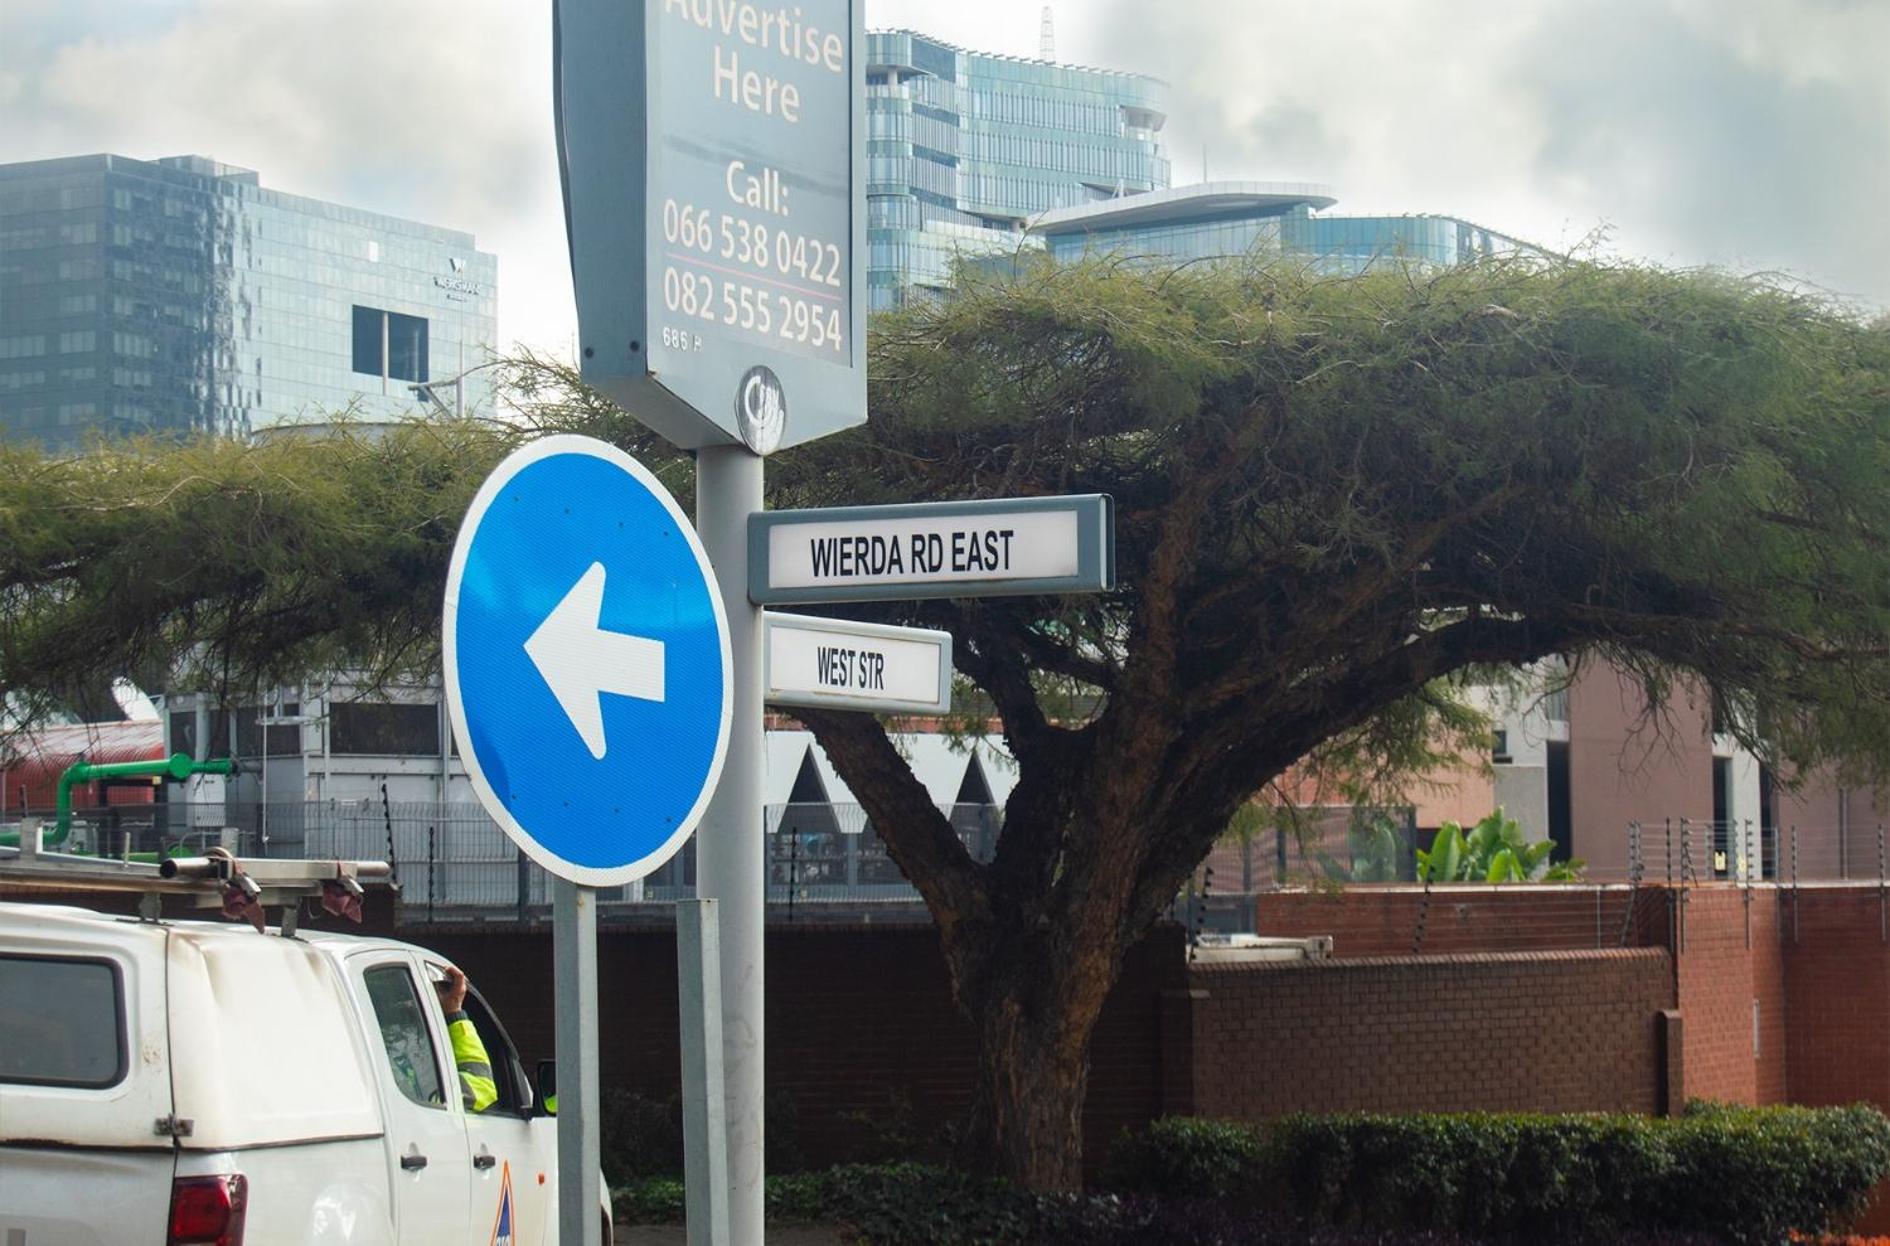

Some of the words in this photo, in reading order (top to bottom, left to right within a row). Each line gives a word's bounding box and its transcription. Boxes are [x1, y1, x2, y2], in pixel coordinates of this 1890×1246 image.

[713, 44, 800, 123] Here
[726, 160, 789, 217] Call:
[663, 198, 713, 252] 066
[720, 214, 768, 268] 538
[776, 230, 841, 288] 0422
[664, 266, 715, 321] 082
[723, 281, 771, 334] 555
[778, 295, 843, 351] 2954
[810, 534, 905, 578] WIERDA
[911, 533, 943, 574] RD
[952, 530, 1015, 573] EAST
[817, 646, 857, 687] WEST
[858, 650, 885, 690] STR
